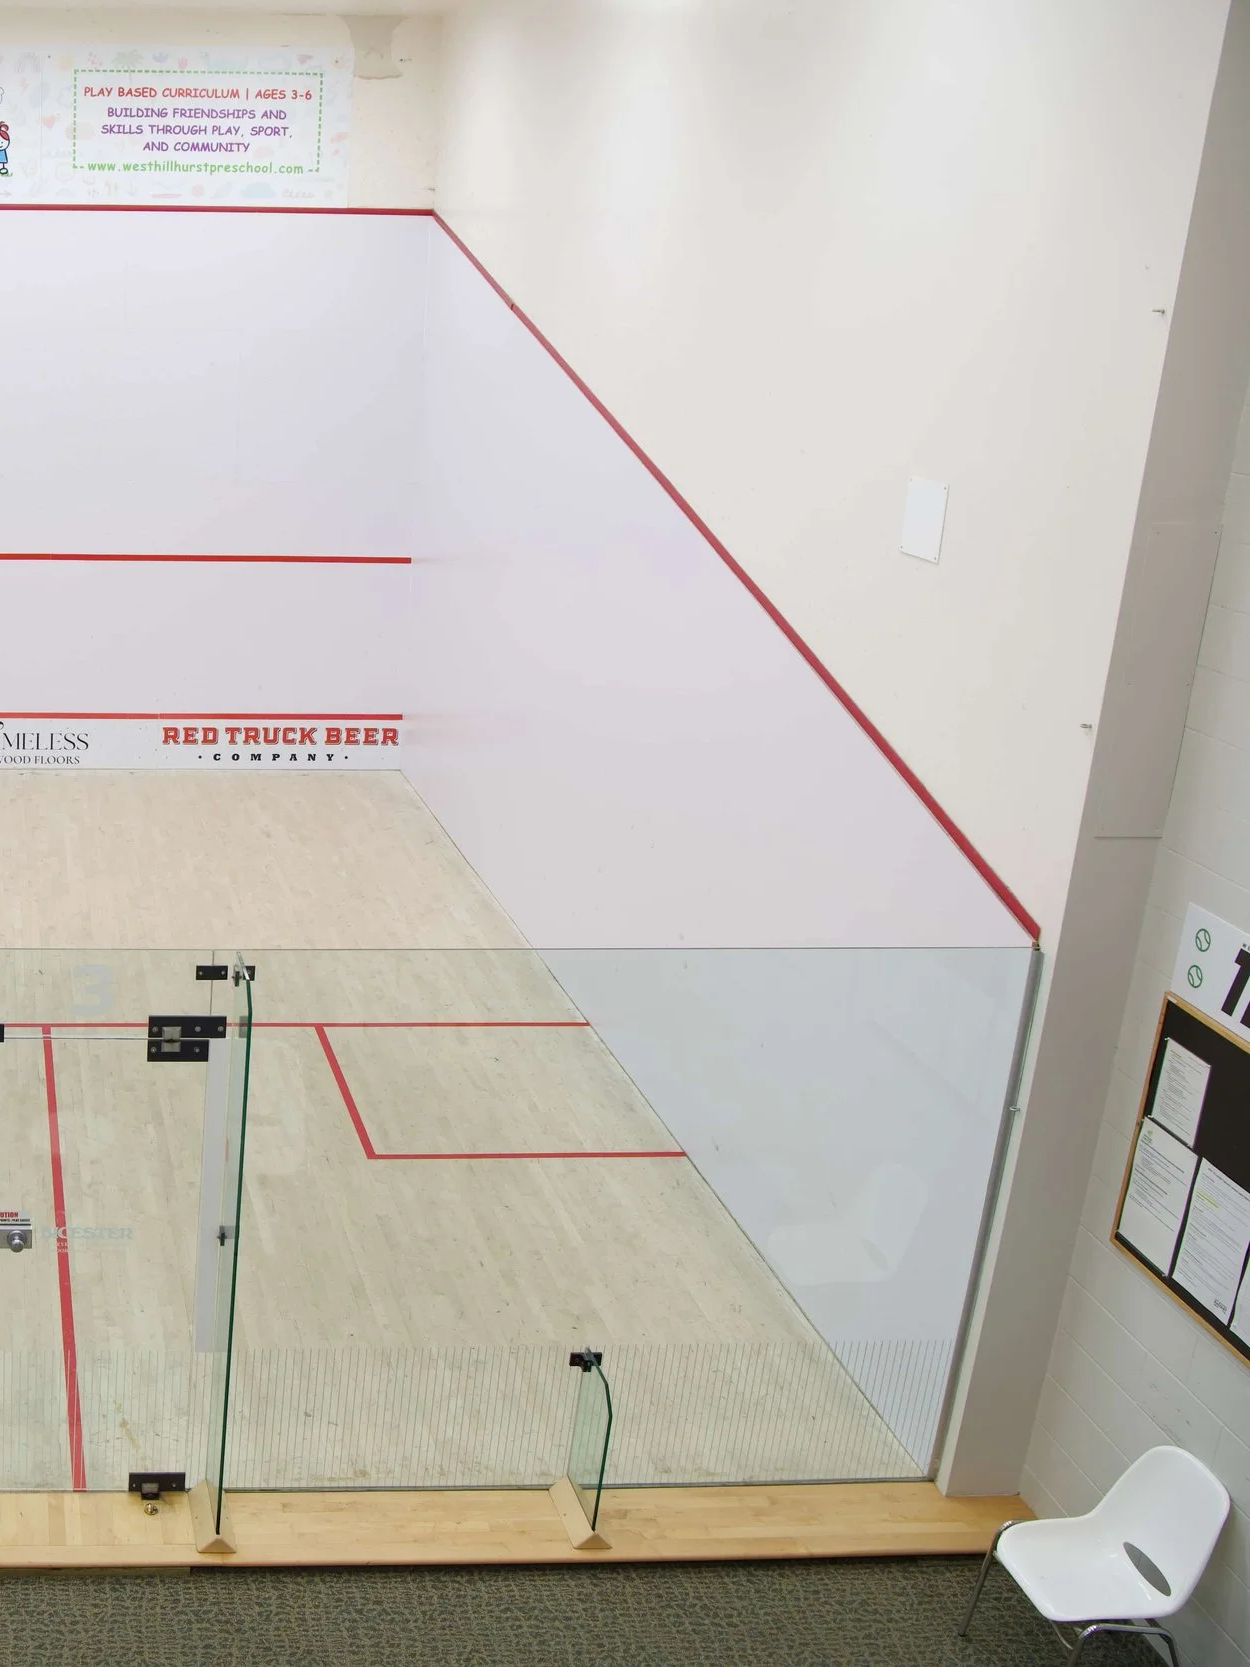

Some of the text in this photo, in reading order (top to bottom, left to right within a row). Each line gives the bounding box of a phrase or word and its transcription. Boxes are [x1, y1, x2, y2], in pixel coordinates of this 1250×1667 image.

[84, 87, 113, 97] PLAY
[118, 87, 157, 98] BASED
[162, 88, 240, 99] CURRICULUM
[255, 89, 286, 99] AGES
[291, 90, 312, 100] 3-6
[107, 108, 287, 120] BUILDING FRIENDSHIPS AND
[101, 124, 292, 138] SKILLS THROUGH PLAY, SPORT,
[143, 142, 250, 153] AND COMMUNITY
[88, 161, 304, 175] www.westhillhurstpreschool.com
[162, 727, 399, 746] RED TRUCK BEER
[35, 755, 80, 764] FLOORS
[213, 753, 335, 761] COMPANY
[71, 964, 114, 1017] 3
